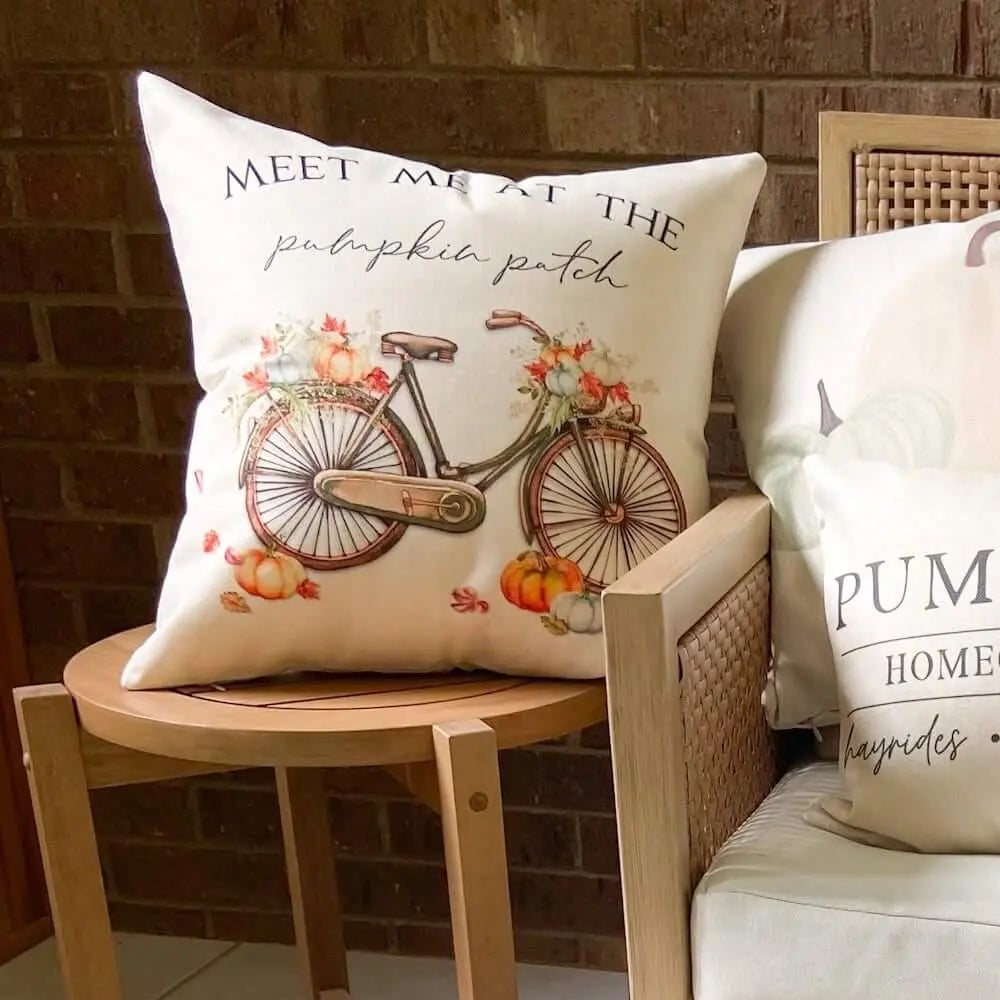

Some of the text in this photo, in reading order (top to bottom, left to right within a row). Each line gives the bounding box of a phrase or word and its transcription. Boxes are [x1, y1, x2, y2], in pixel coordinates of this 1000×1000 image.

[224, 154, 360, 199] MEET
[389, 167, 469, 194] ME
[596, 192, 686, 251] THE
[264, 219, 629, 288] pumpkin patch
[844, 713, 968, 776] hayrides
